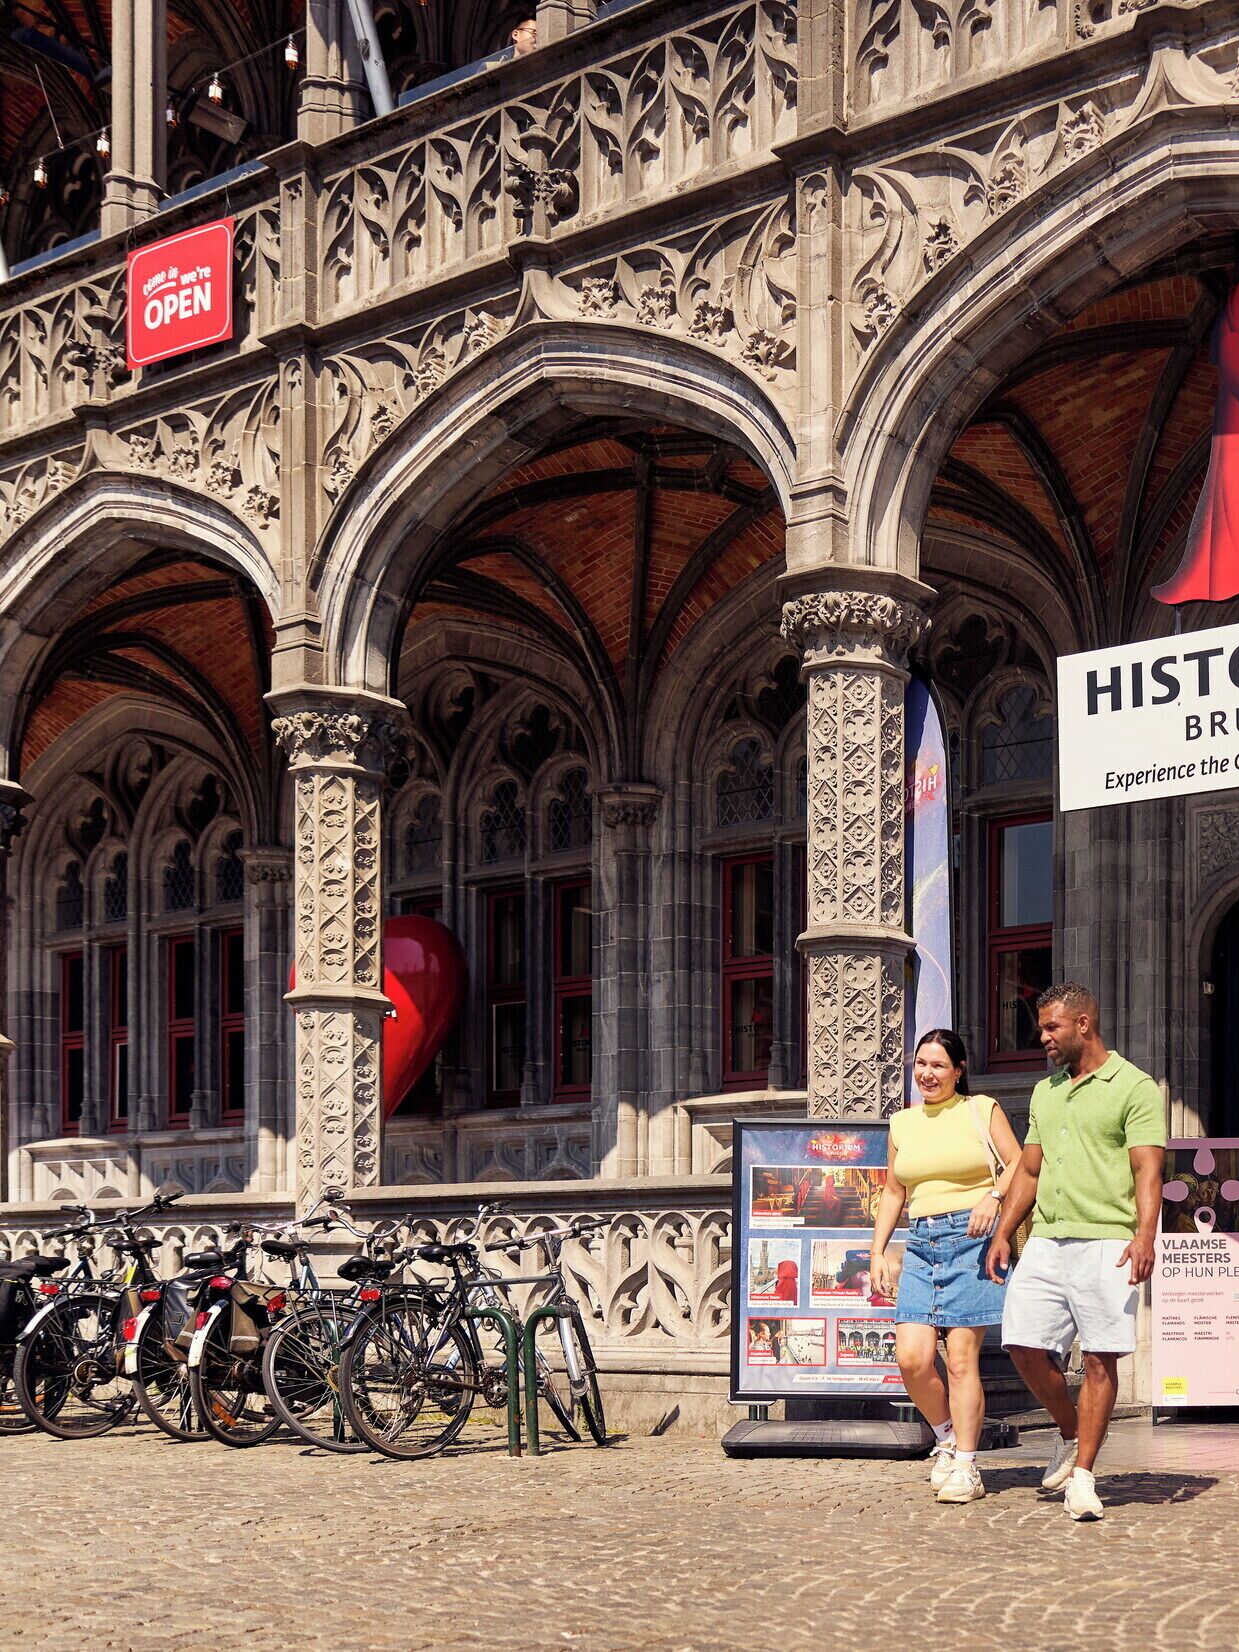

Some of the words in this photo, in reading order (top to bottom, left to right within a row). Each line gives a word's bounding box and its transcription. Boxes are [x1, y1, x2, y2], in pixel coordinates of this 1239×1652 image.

[180, 266, 211, 285] we're
[144, 282, 211, 330] OPEN
[1105, 760, 1195, 792] Experience
[1200, 755, 1230, 777] the
[812, 1143, 861, 1151] HISTORIUM
[1162, 1239, 1227, 1250] VLAAMSE
[1162, 1253, 1231, 1264] MEESTERS
[1162, 1267, 1181, 1278] OP
[1185, 1267, 1214, 1278] HUN
